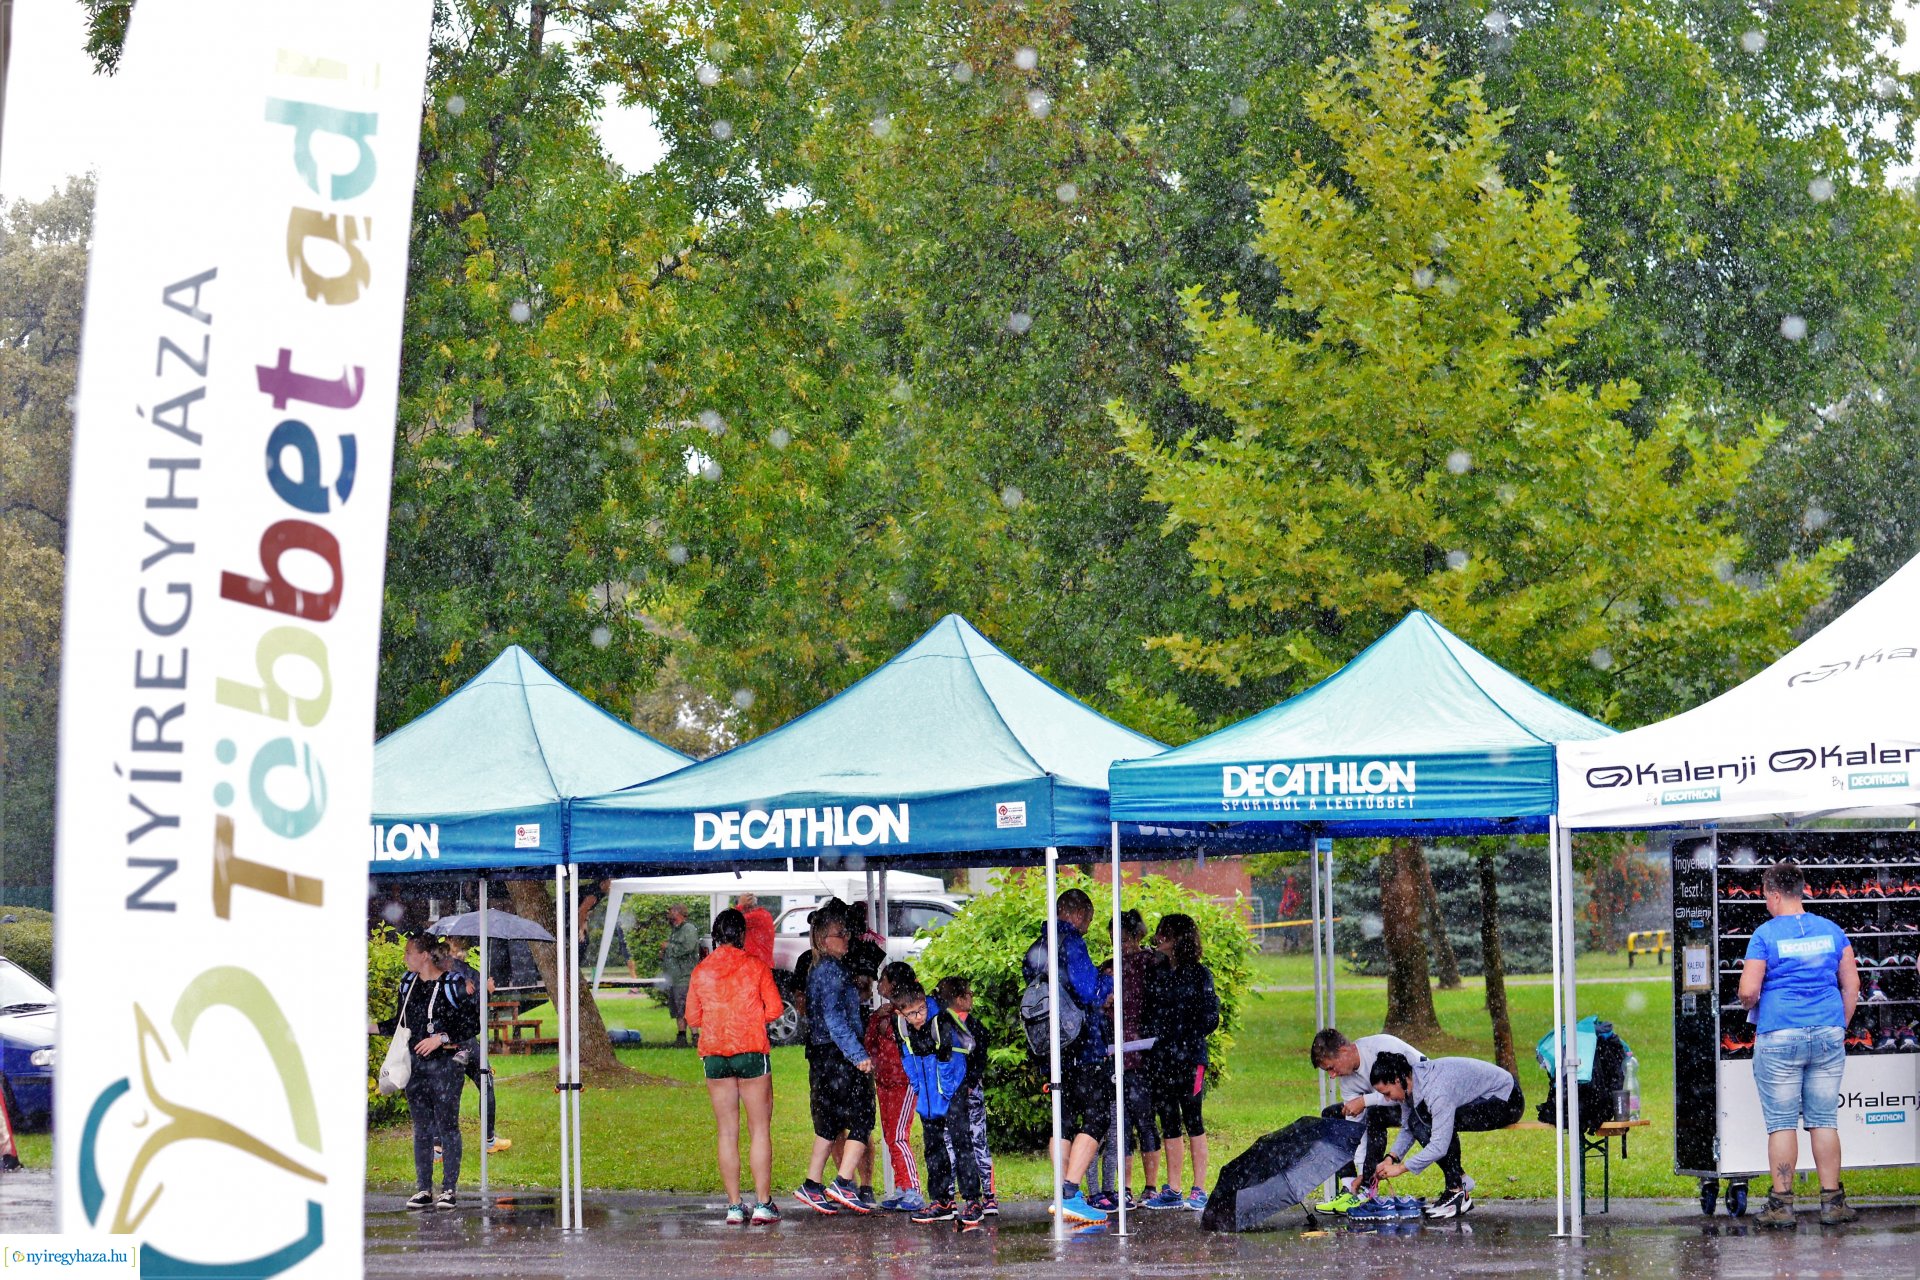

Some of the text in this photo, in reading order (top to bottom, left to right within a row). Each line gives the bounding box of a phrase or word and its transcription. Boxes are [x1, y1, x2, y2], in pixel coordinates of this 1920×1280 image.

[115, 266, 218, 913] NYÍREGYHÁZA
[212, 347, 365, 921] Többet
[1222, 760, 1416, 798] DECATHLON
[1636, 755, 1756, 785] Kalenji
[1309, 797, 1318, 810] A
[370, 823, 440, 861] LON
[693, 803, 910, 851] DECATHLON
